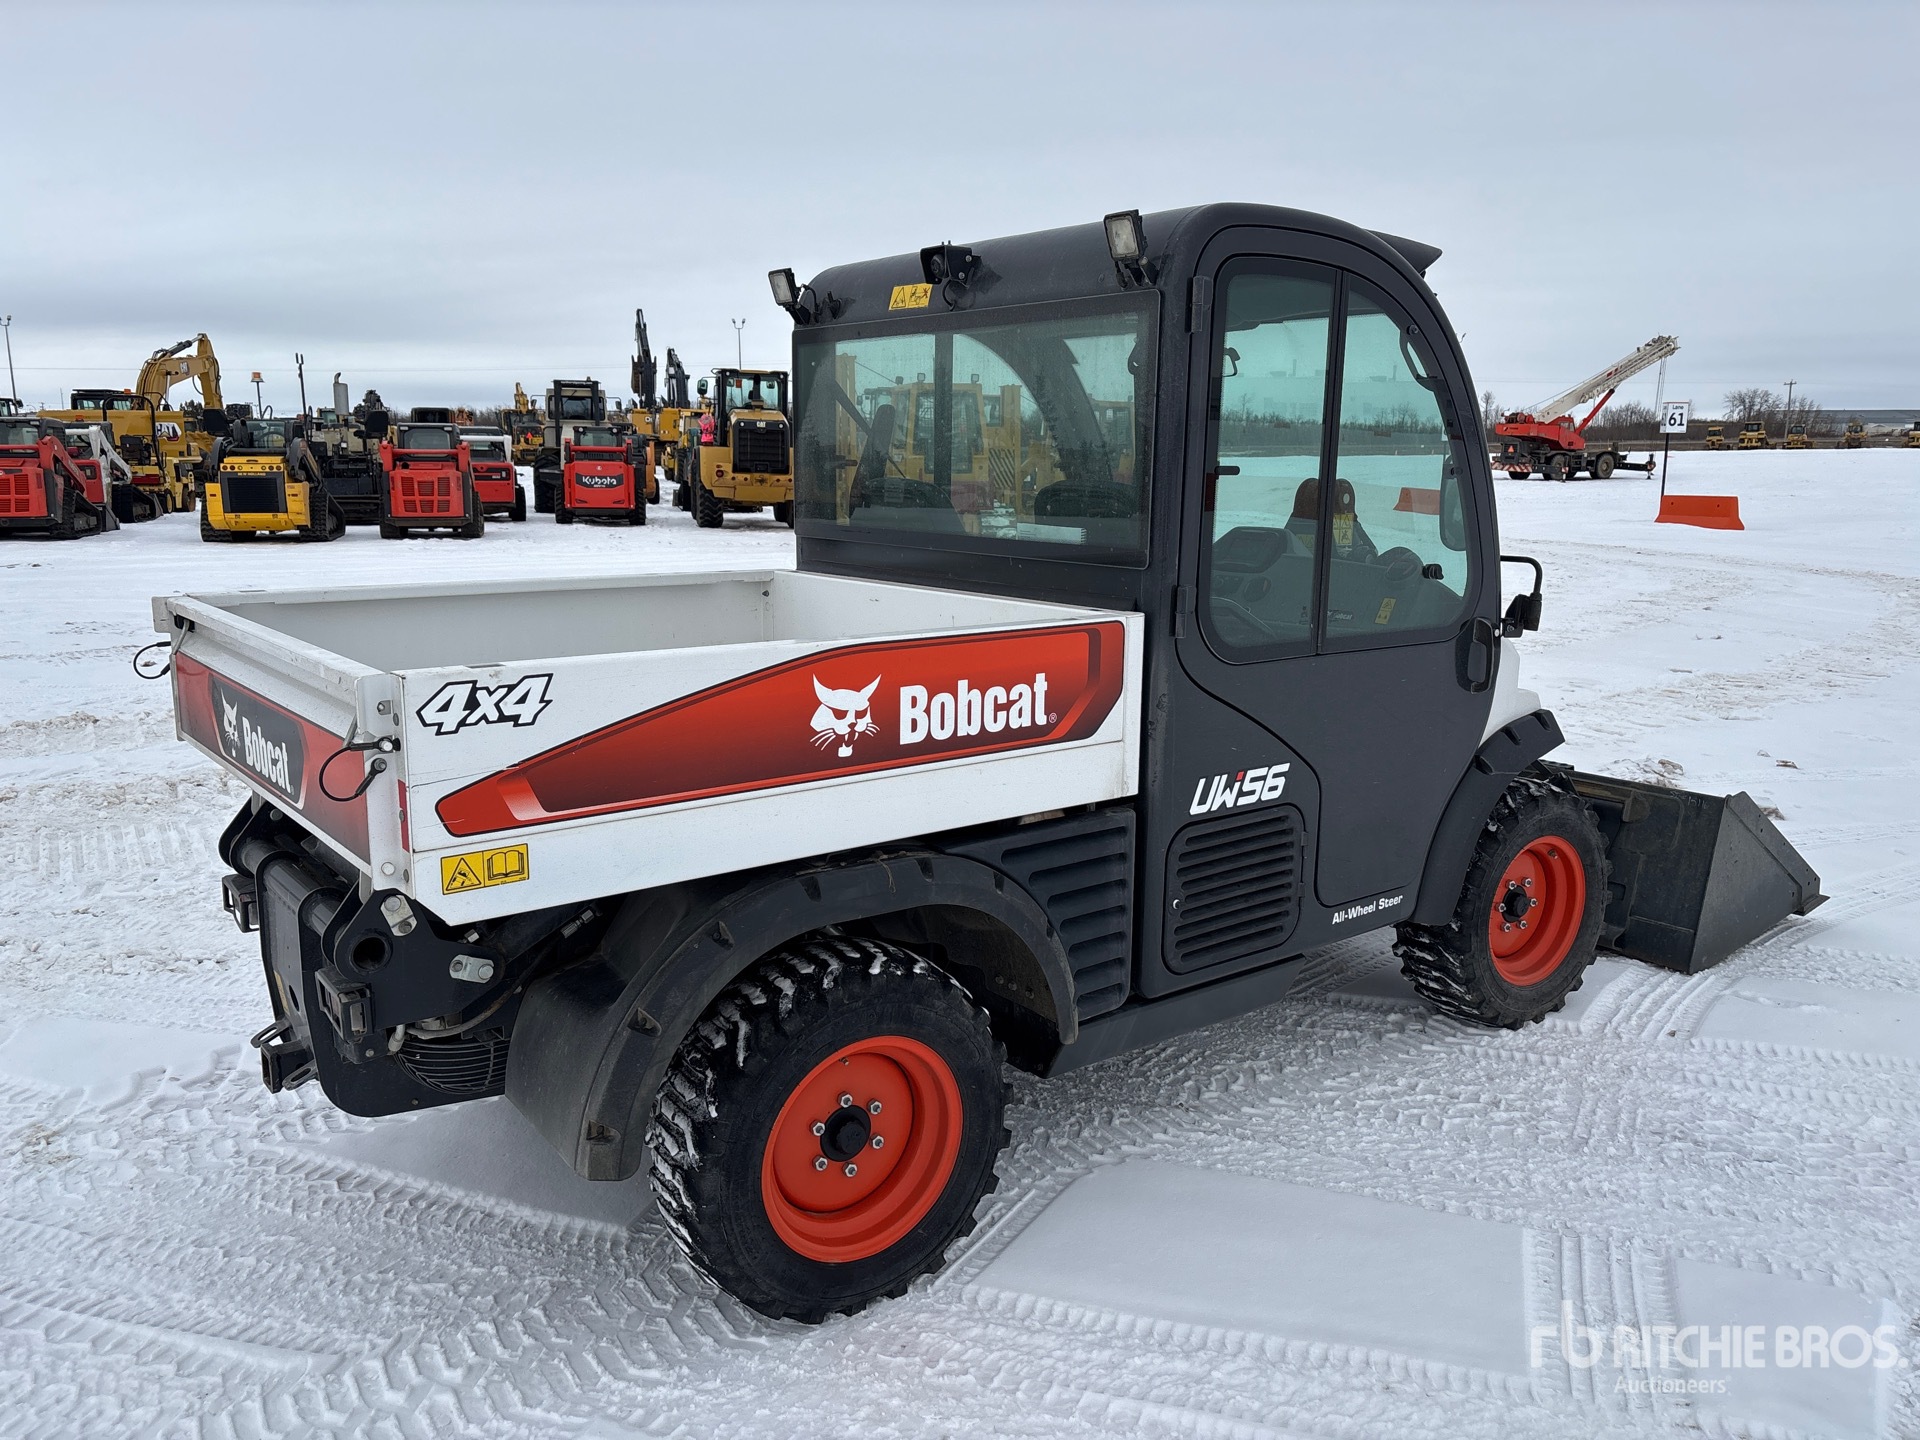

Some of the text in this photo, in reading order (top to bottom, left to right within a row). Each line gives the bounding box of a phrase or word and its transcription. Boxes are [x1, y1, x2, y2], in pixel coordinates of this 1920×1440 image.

[156, 423, 176, 438] CAT
[1668, 412, 1685, 427] 61
[582, 475, 617, 485] Kubota
[416, 673, 553, 736] 4x4
[900, 672, 1048, 745] Bobcat
[242, 716, 291, 794] Bobcat
[1189, 763, 1290, 816] UW56
[1332, 894, 1403, 925] All-Wheel Steer
